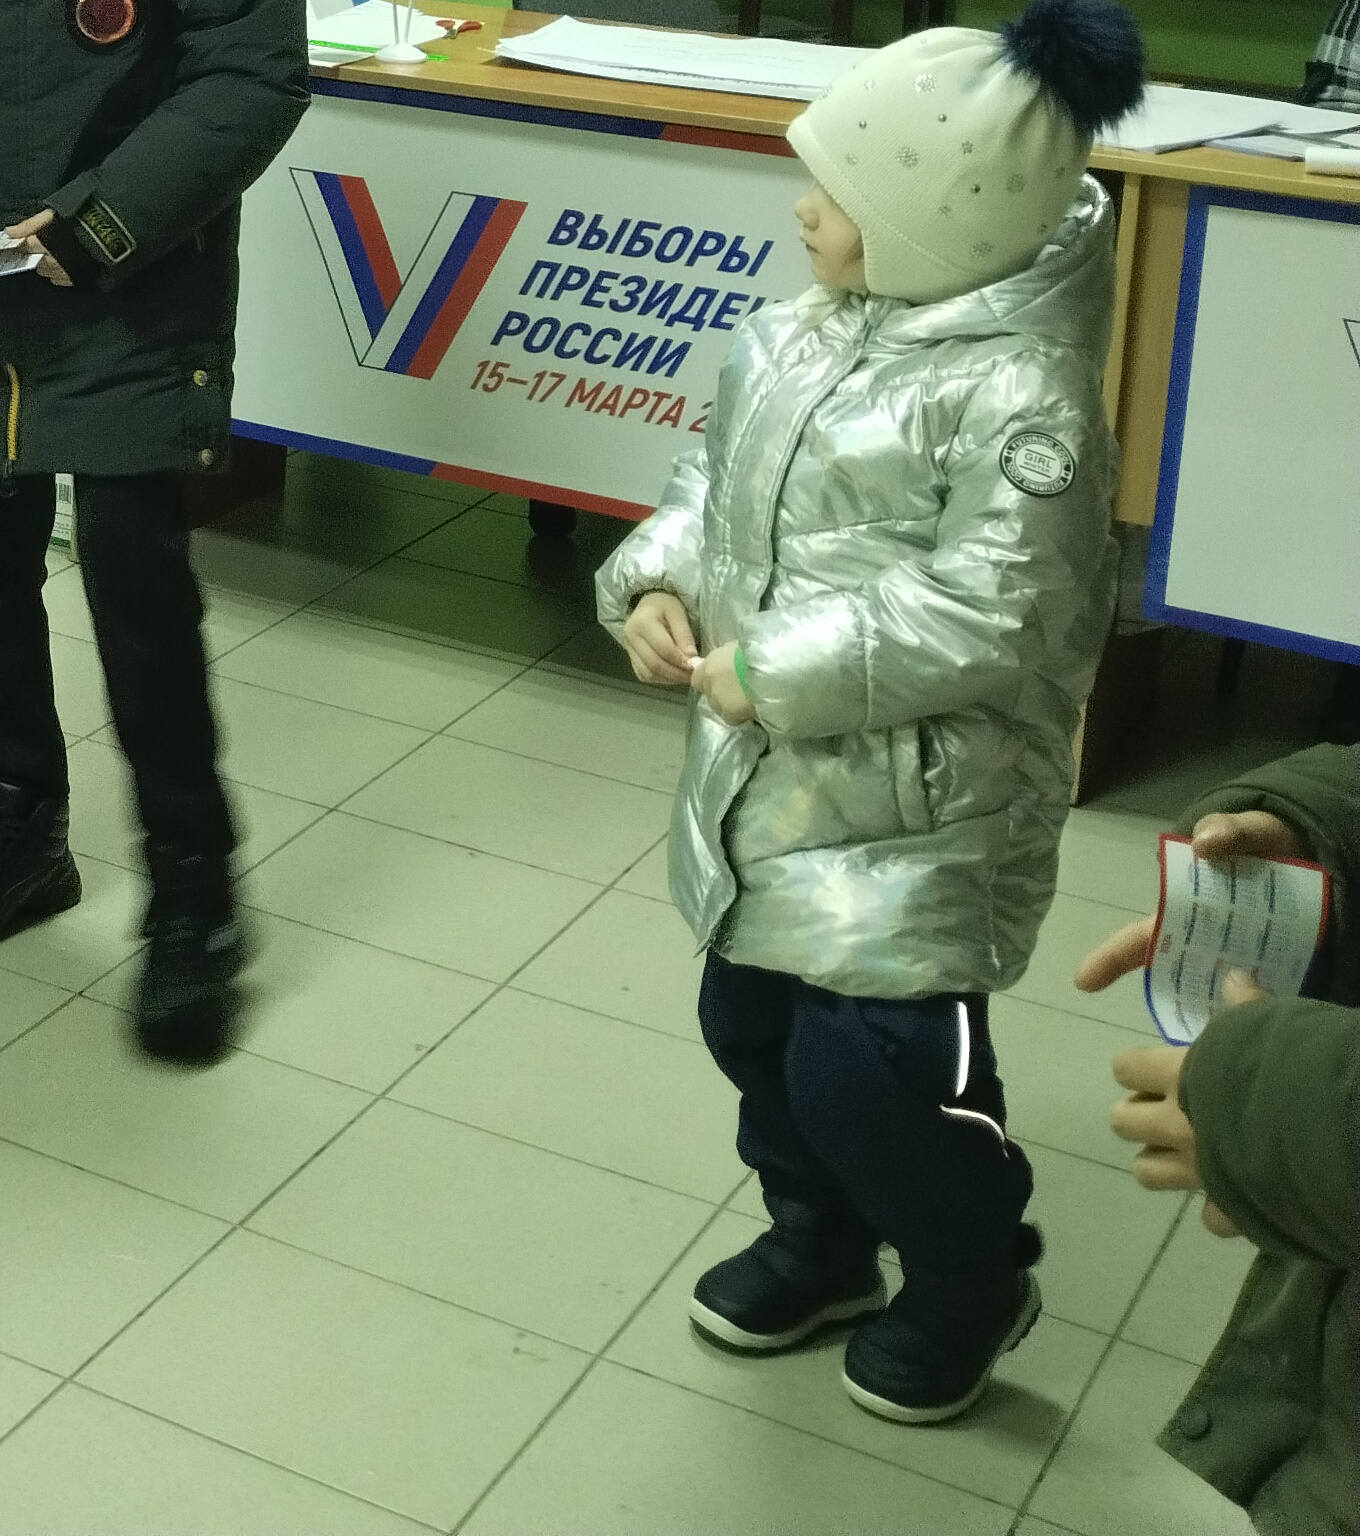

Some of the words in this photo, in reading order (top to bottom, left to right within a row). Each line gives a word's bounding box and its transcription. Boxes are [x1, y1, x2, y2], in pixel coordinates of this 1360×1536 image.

[547, 208, 775, 277] ВЫБОРЫ
[490, 310, 694, 378] РОССИИ
[566, 377, 686, 429] МАРТА
[1024, 452, 1052, 469] GIRL
